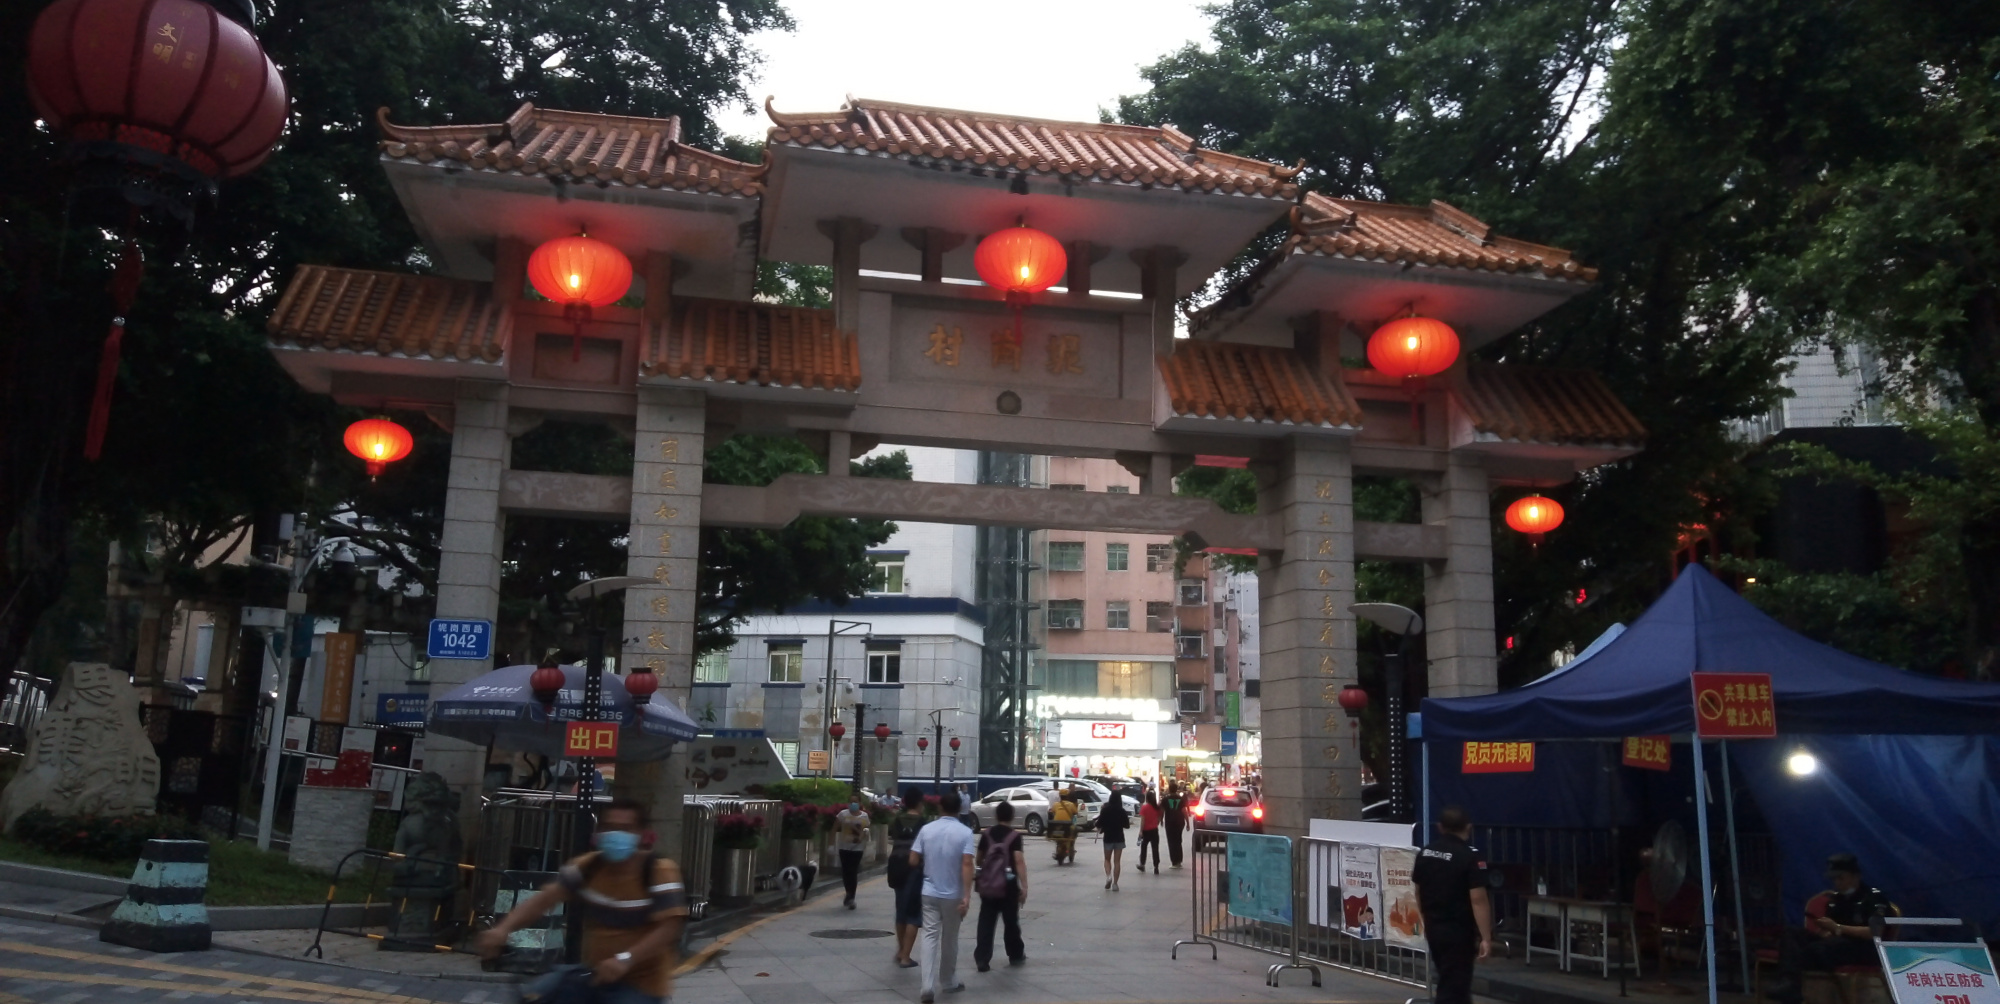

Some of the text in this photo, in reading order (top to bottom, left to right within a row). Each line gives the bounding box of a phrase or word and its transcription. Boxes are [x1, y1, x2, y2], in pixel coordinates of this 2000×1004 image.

[151, 22, 178, 64] 文明
[437, 622, 483, 634] 坭岗西路
[442, 633, 477, 648] 1042
[1723, 682, 1771, 703] 共享单车
[1725, 707, 1772, 728] 禁止入内
[569, 726, 614, 750] 出口
[1626, 736, 1667, 764] 登记处
[1906, 972, 1985, 988] 坭岗社区防疫
